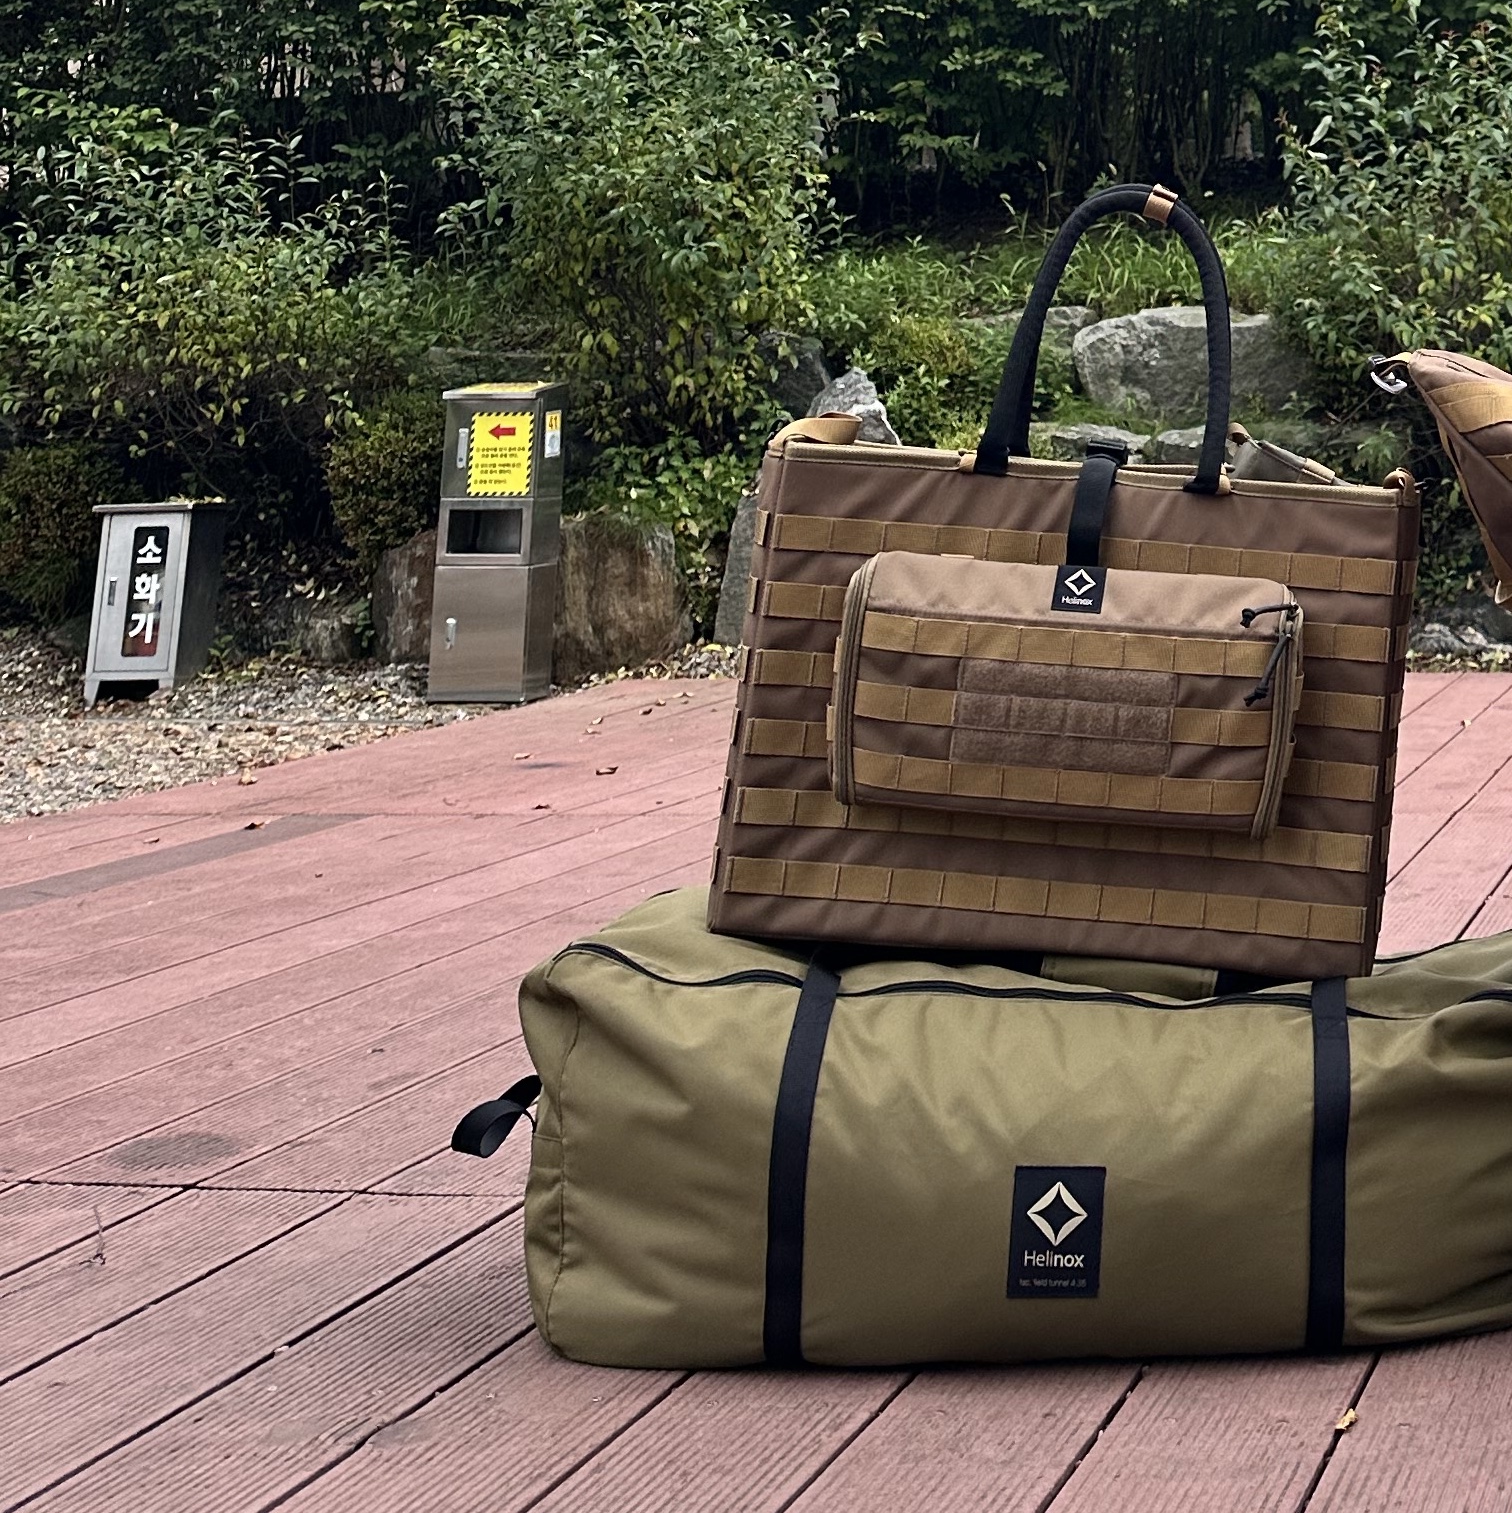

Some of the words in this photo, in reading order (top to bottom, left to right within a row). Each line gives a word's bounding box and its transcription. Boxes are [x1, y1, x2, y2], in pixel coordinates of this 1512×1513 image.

[548, 415, 558, 430] 41
[128, 535, 162, 644] 소화기
[1061, 595, 1094, 606] Helinox
[1023, 1249, 1085, 1268] Helinox
